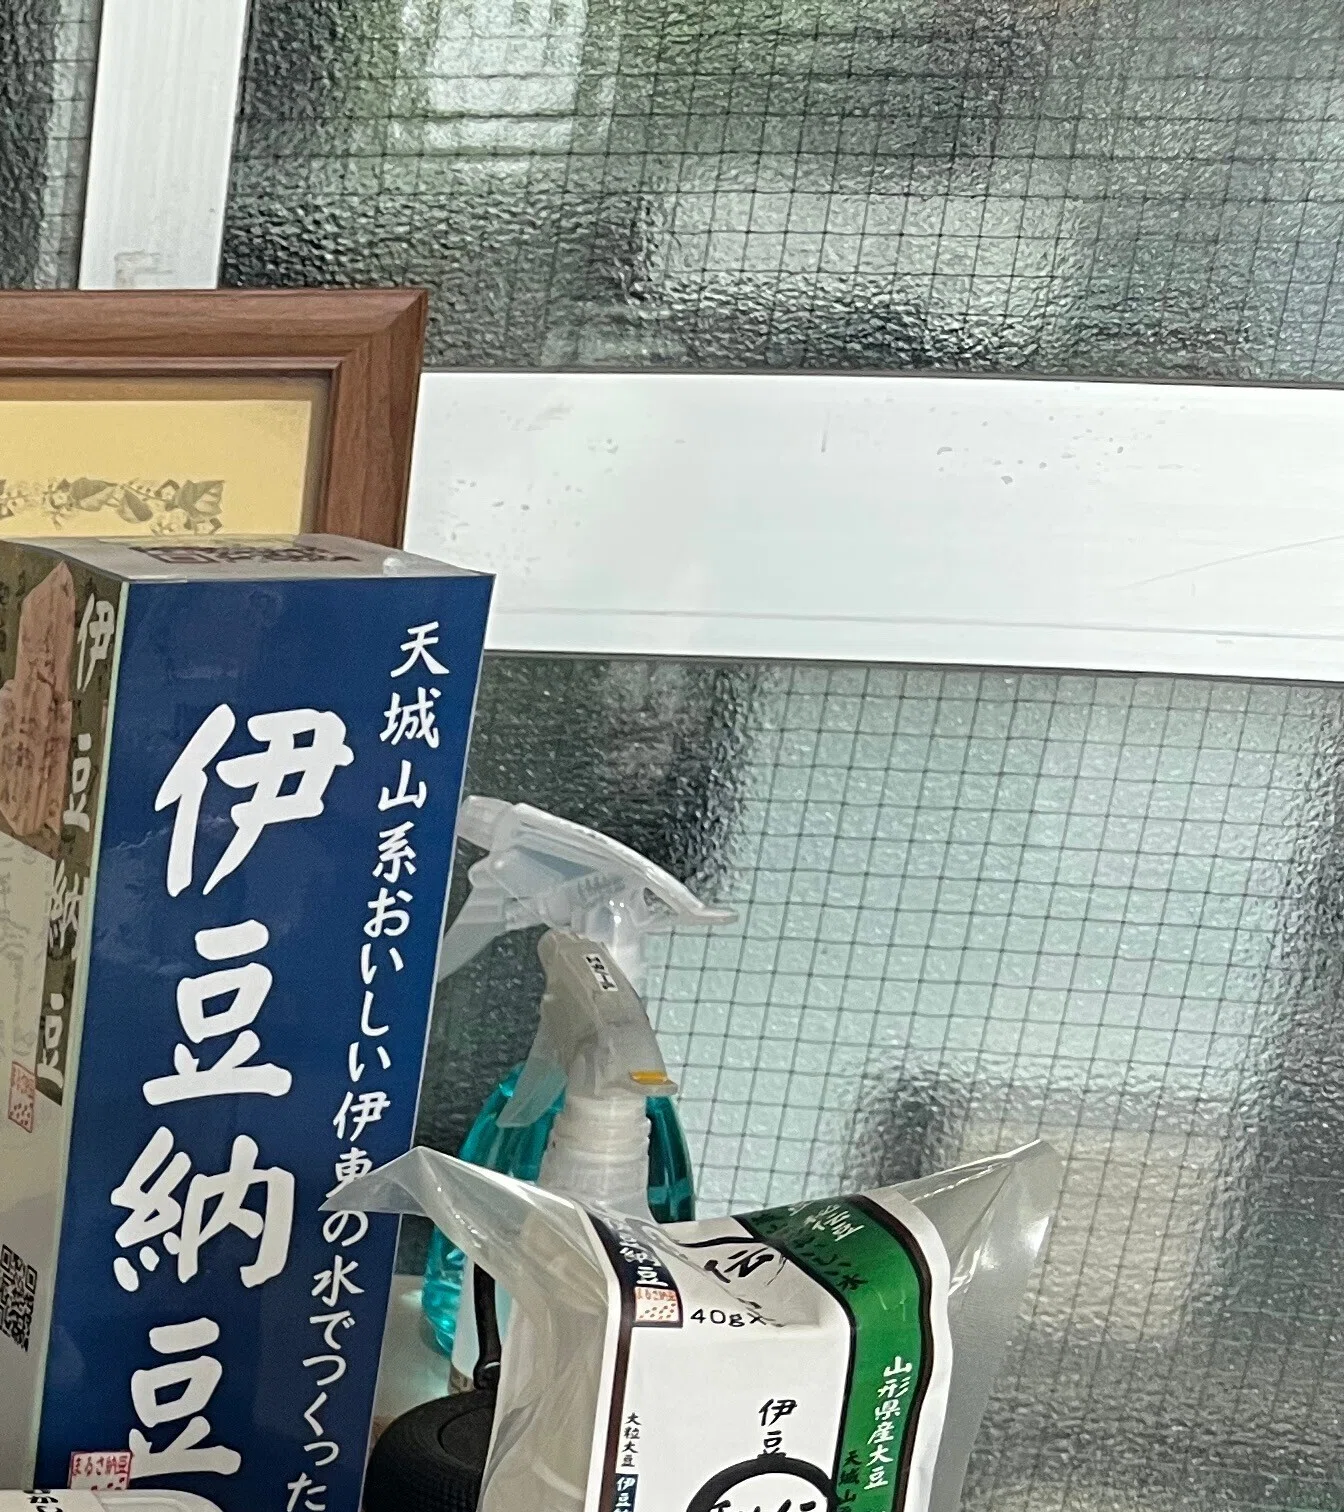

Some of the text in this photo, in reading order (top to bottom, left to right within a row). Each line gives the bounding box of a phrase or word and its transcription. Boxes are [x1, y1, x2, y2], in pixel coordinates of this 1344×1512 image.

[36, 592, 115, 1092] 伊豆納豆
[110, 703, 355, 1481] 伊豆納豆
[621, 1412, 642, 1468] 大粒大豆
[758, 1398, 798, 1459] 伊豆
[864, 1356, 912, 1491] 山形県産大豆
